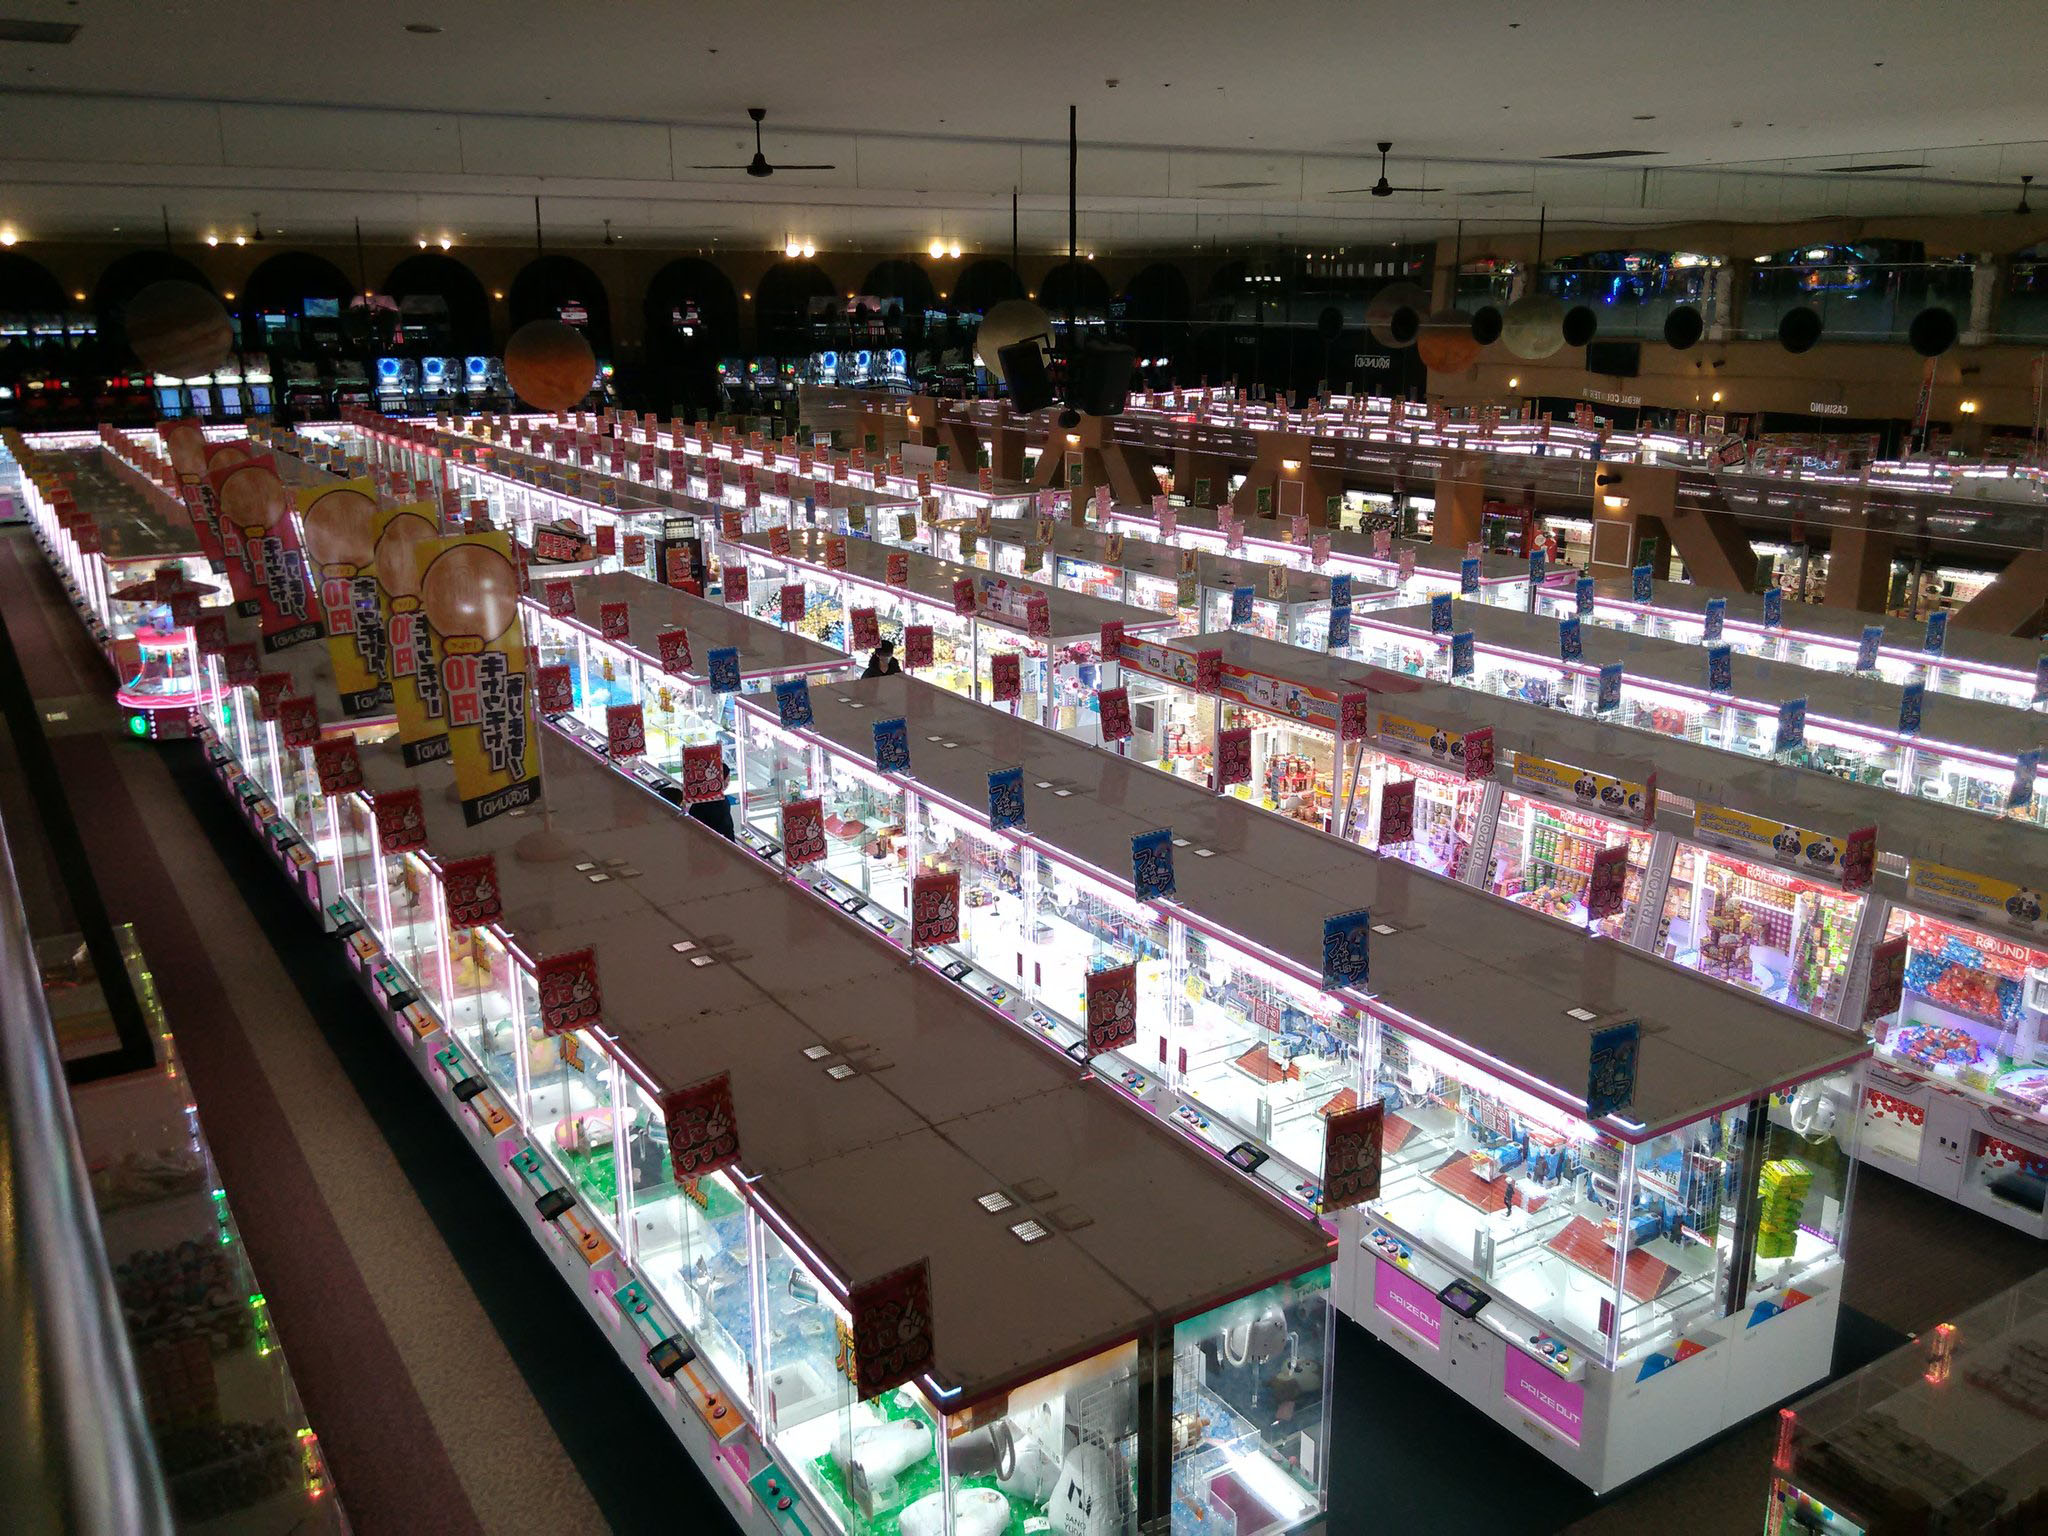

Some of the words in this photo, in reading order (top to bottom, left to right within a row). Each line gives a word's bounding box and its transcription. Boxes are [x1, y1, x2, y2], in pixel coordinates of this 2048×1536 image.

[1473, 813, 1493, 869] TRYPOD
[1640, 866, 1664, 929] TRYPOD
[1975, 936, 2031, 962] ROUND1
[1065, 1512, 1087, 1530] SANO
